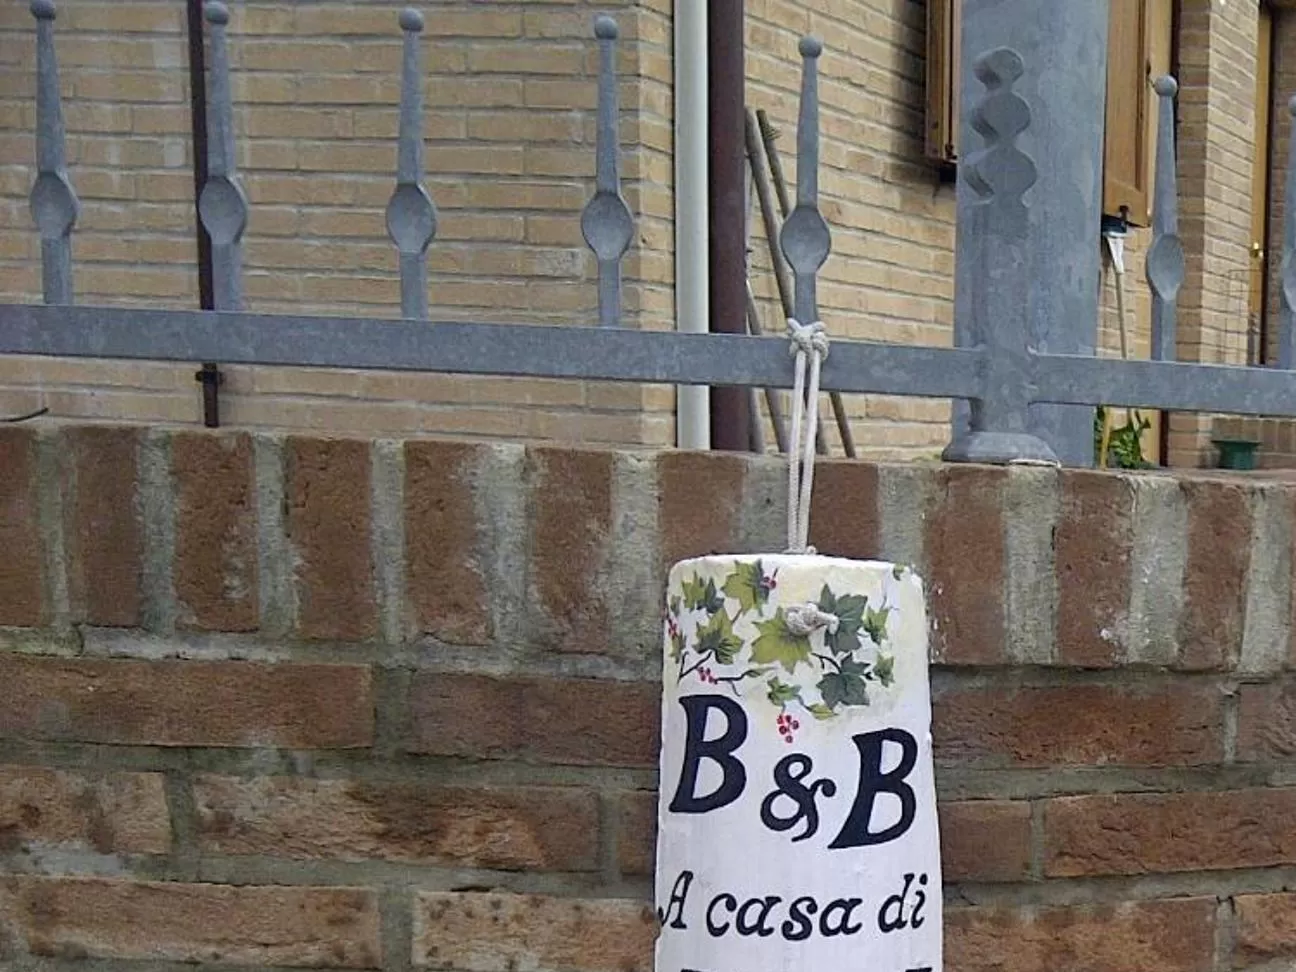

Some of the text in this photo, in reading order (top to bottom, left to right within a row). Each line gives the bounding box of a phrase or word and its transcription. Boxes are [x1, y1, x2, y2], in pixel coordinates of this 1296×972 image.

[669, 694, 918, 850] B&B
[658, 870, 927, 941] A casa di
